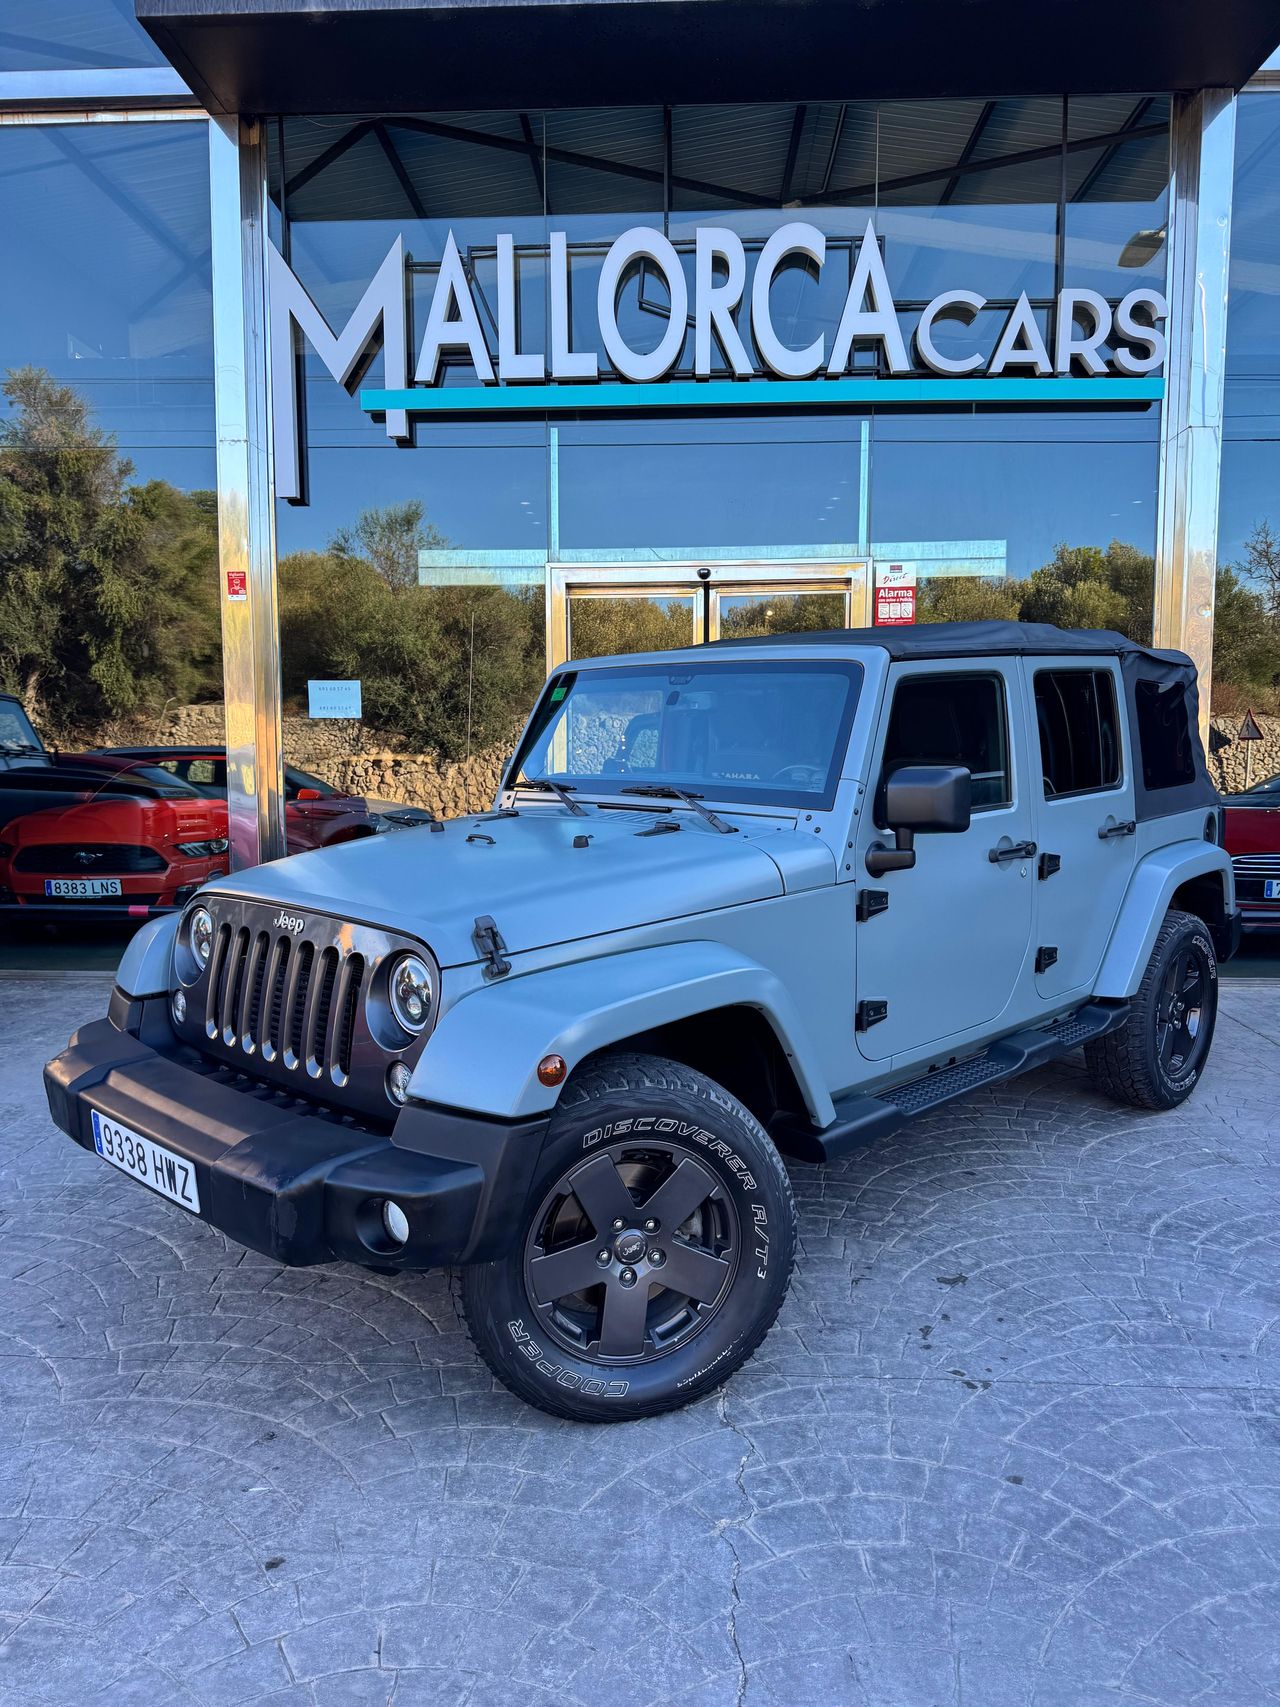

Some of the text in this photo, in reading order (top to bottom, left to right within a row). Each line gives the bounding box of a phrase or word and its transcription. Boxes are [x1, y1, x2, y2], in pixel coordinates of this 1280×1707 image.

[268, 218, 1169, 500] MALLORCA CARS
[878, 588, 913, 598] Alarma
[54, 881, 118, 894] 8383 LNS
[273, 910, 304, 936] Jeep
[1192, 935, 1217, 979] COOPER
[103, 1123, 193, 1204] 9338 HWZ
[582, 1117, 757, 1192] DISCOVERER
[622, 1241, 641, 1256] Jeep
[507, 1319, 630, 1398] COOPER
